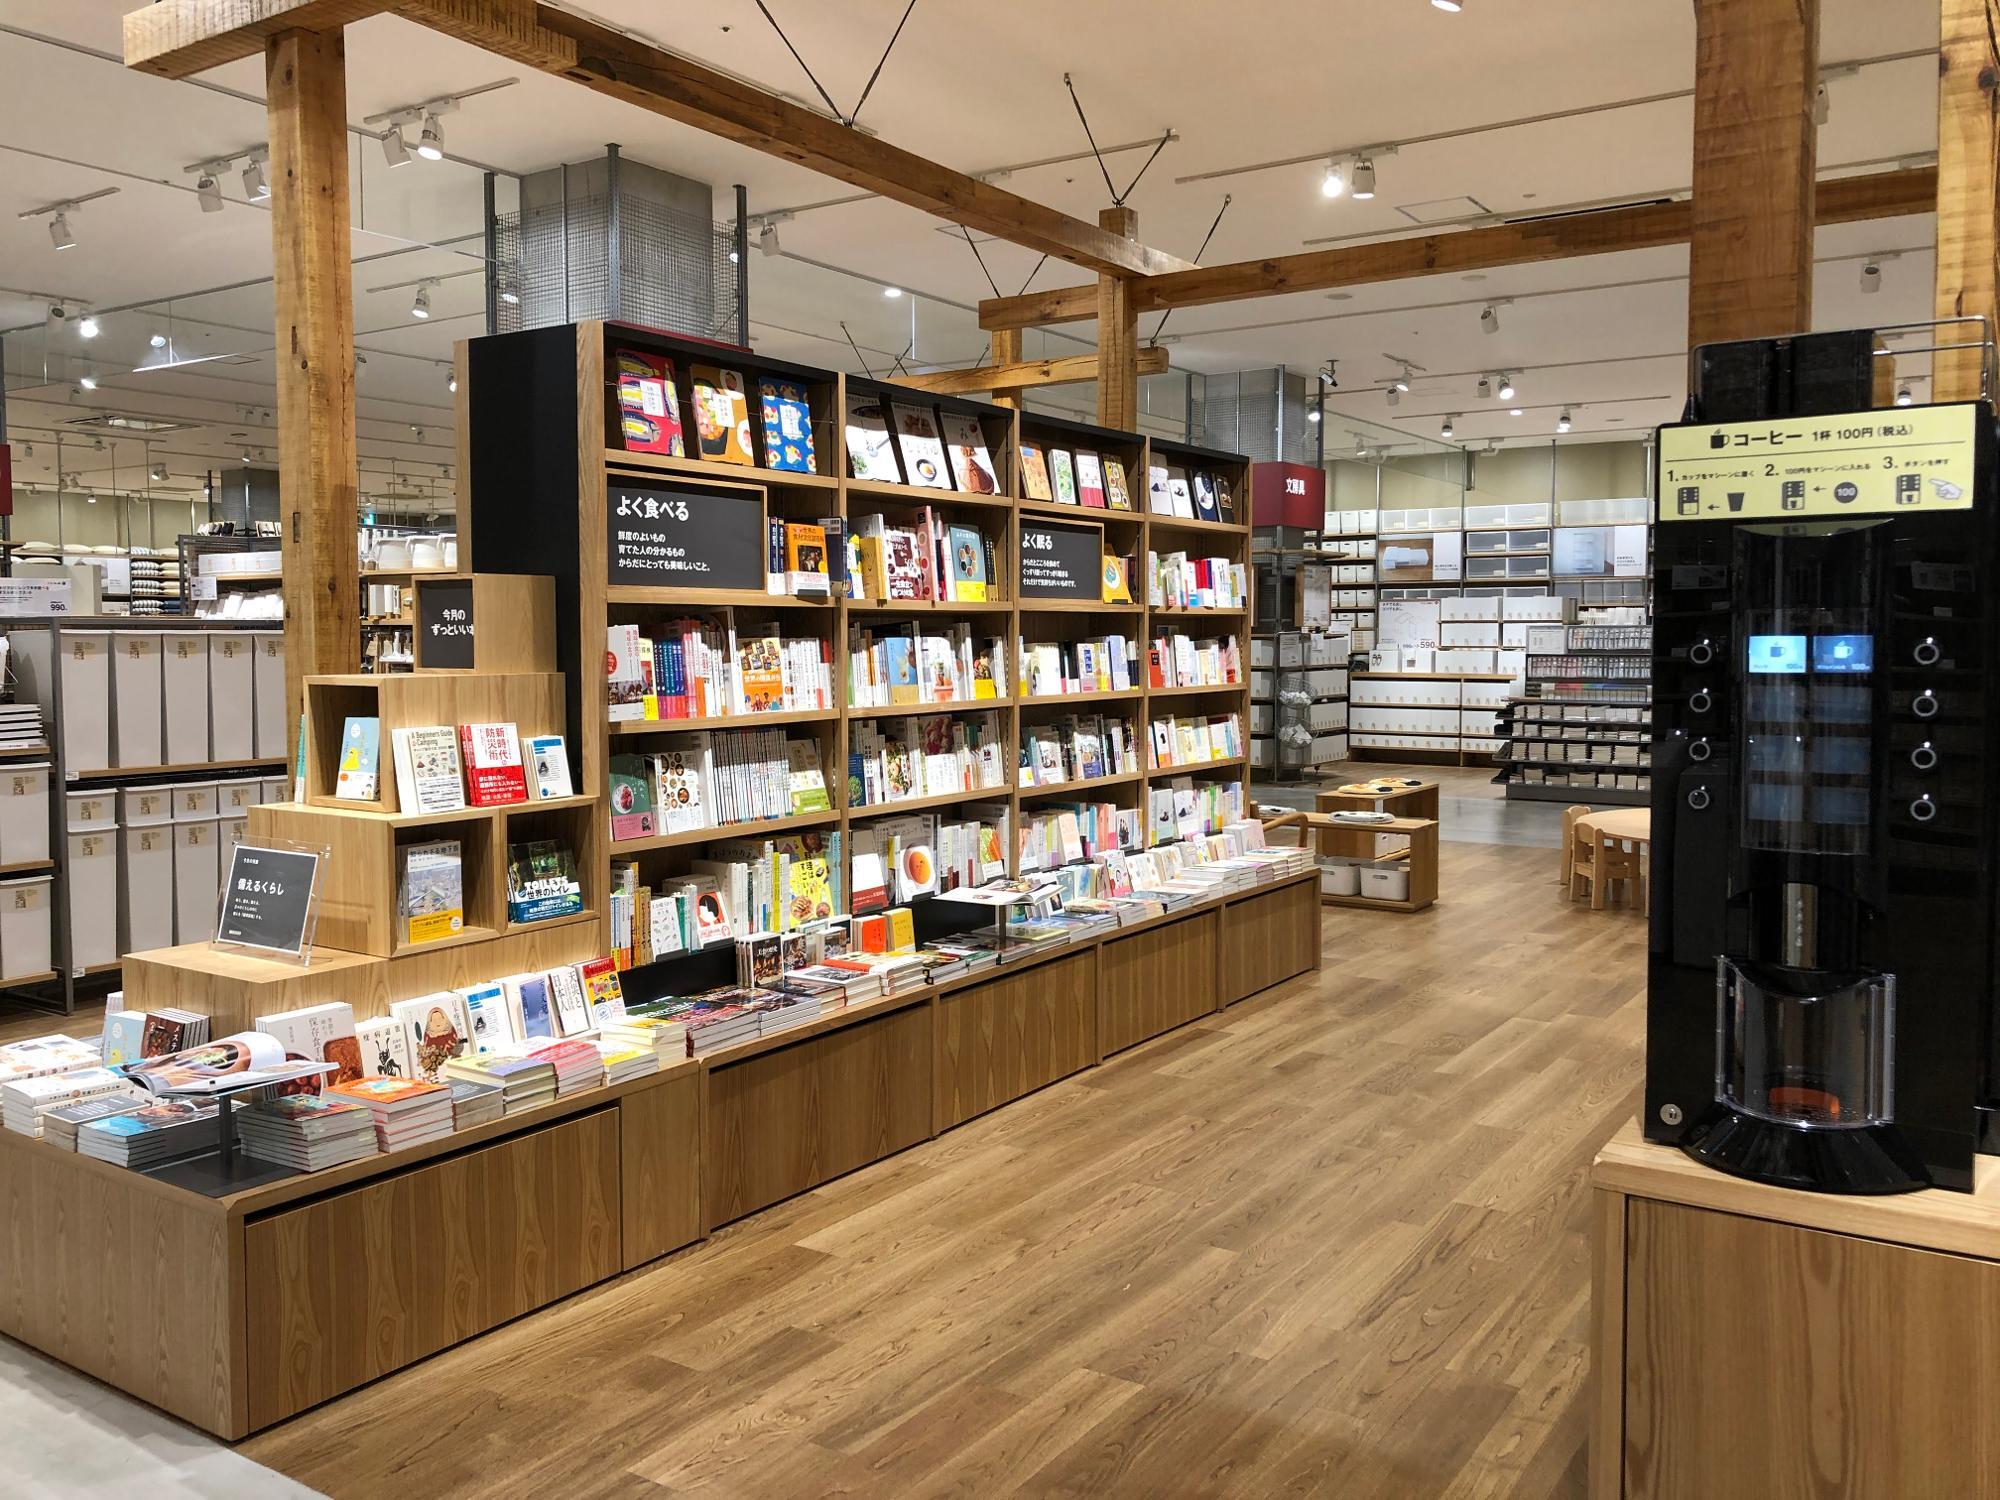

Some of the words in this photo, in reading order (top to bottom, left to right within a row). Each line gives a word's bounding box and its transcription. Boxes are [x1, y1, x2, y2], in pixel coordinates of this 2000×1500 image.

[1734, 430, 1802, 446] コーヒー
[1812, 430, 1831, 441] 1杯
[1883, 456, 1898, 469] 3.
[1904, 459, 1950, 468] ボタンを押す
[1667, 470, 1679, 482] 1.
[1765, 464, 1779, 476] 2.
[1285, 477, 1306, 496] 文房具
[1837, 487, 1856, 497] 100
[616, 495, 689, 521] よく食べる
[617, 530, 666, 543] 鮮度のよいもの
[1022, 532, 1053, 551] よく眠る
[618, 544, 686, 557] 育てた人の分かるもの
[618, 558, 711, 572] からだにとっても美味しいこと。
[442, 608, 466, 621] 今月の
[1420, 641, 1435, 649] 590
[237, 878, 284, 896] 備えるくらし
[527, 885, 569, 899] 世界のトイレ
[553, 975, 568, 1013] 日本人
[568, 970, 581, 1009] 天災と
